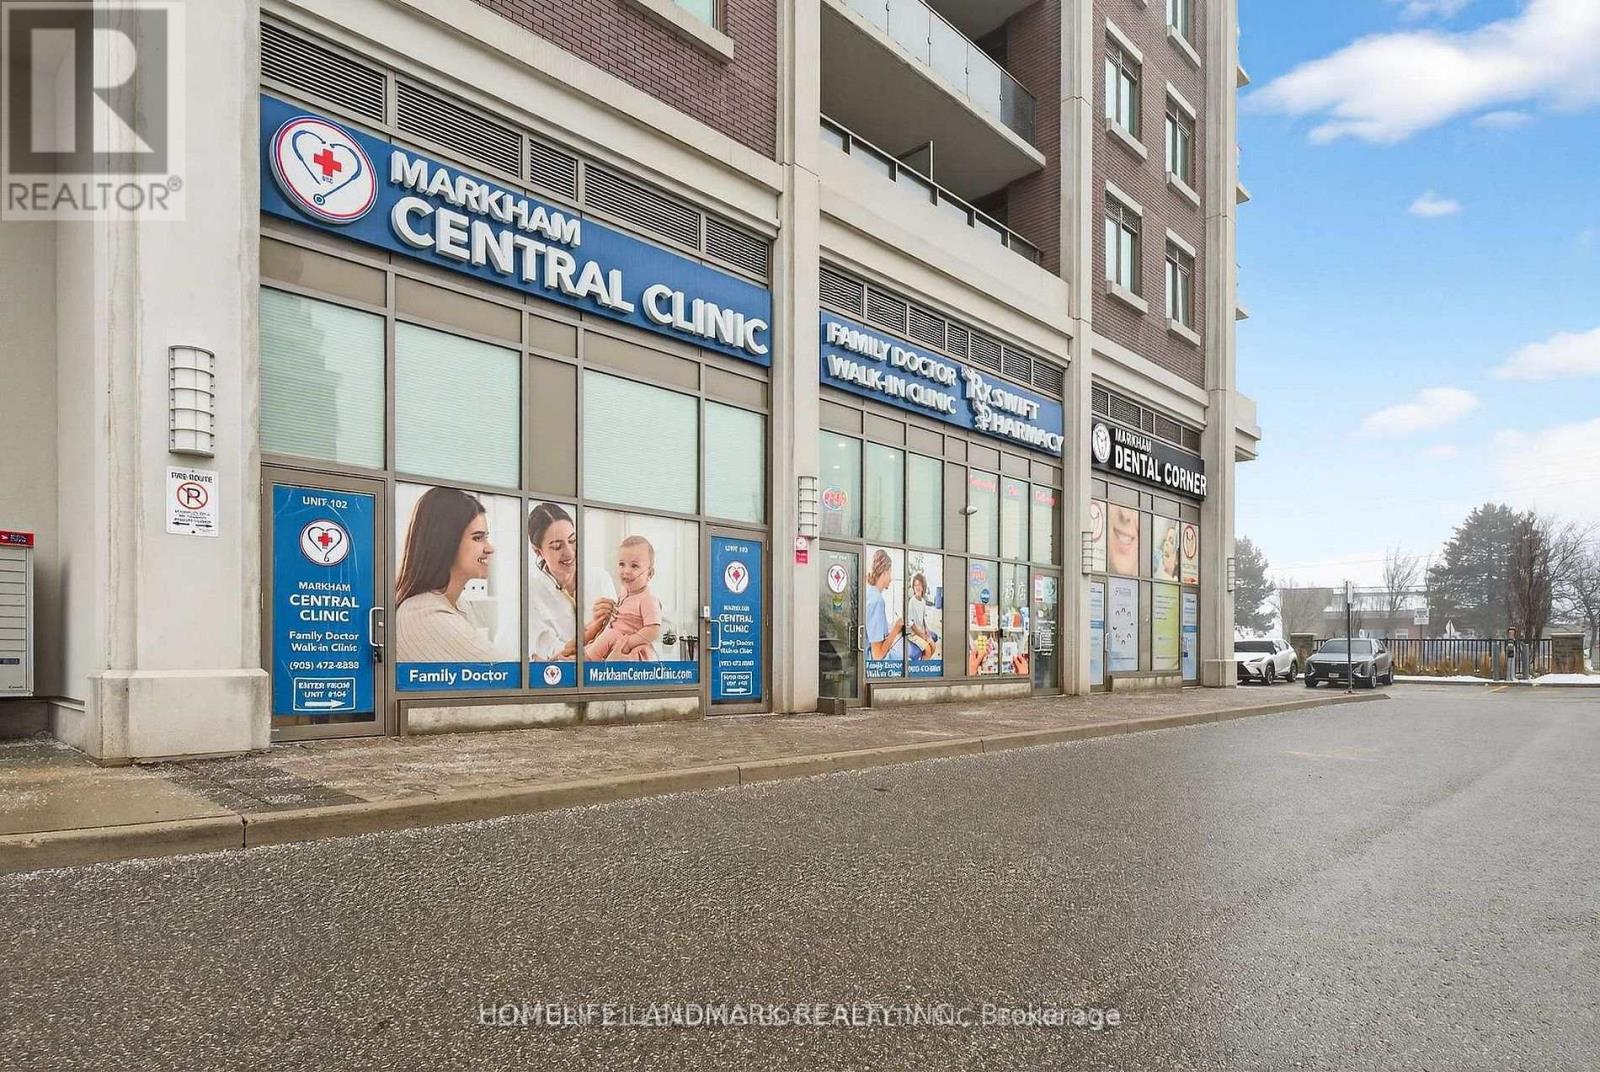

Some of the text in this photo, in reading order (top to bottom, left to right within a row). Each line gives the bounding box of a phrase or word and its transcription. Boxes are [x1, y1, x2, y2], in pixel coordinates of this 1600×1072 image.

[390, 151, 581, 246] MARKHAM
[391, 197, 769, 355] CENTRAL CLINIC
[827, 322, 957, 386] FAMILY DOCTOR
[827, 354, 957, 414] WALK-IN CLINIC
[991, 388, 1040, 420] SWIFT
[976, 405, 1065, 451] PHARMACY
[1115, 428, 1152, 453] MARKHAM
[1115, 445, 1207, 496] DENTAL CORNER
[302, 496, 348, 509] UNIT 102
[298, 581, 351, 592] MARKHAM
[289, 594, 360, 608] CENTRAL
[299, 609, 350, 622] CLINIC
[719, 613, 754, 624] CENTRAL
[289, 631, 360, 642] Family Doctor
[291, 643, 358, 652] Walk-in Clinic
[289, 661, 315, 671] (905)
[589, 664, 693, 682] MarkhamCentralClinic.com
[409, 668, 508, 685] Family Doctor
